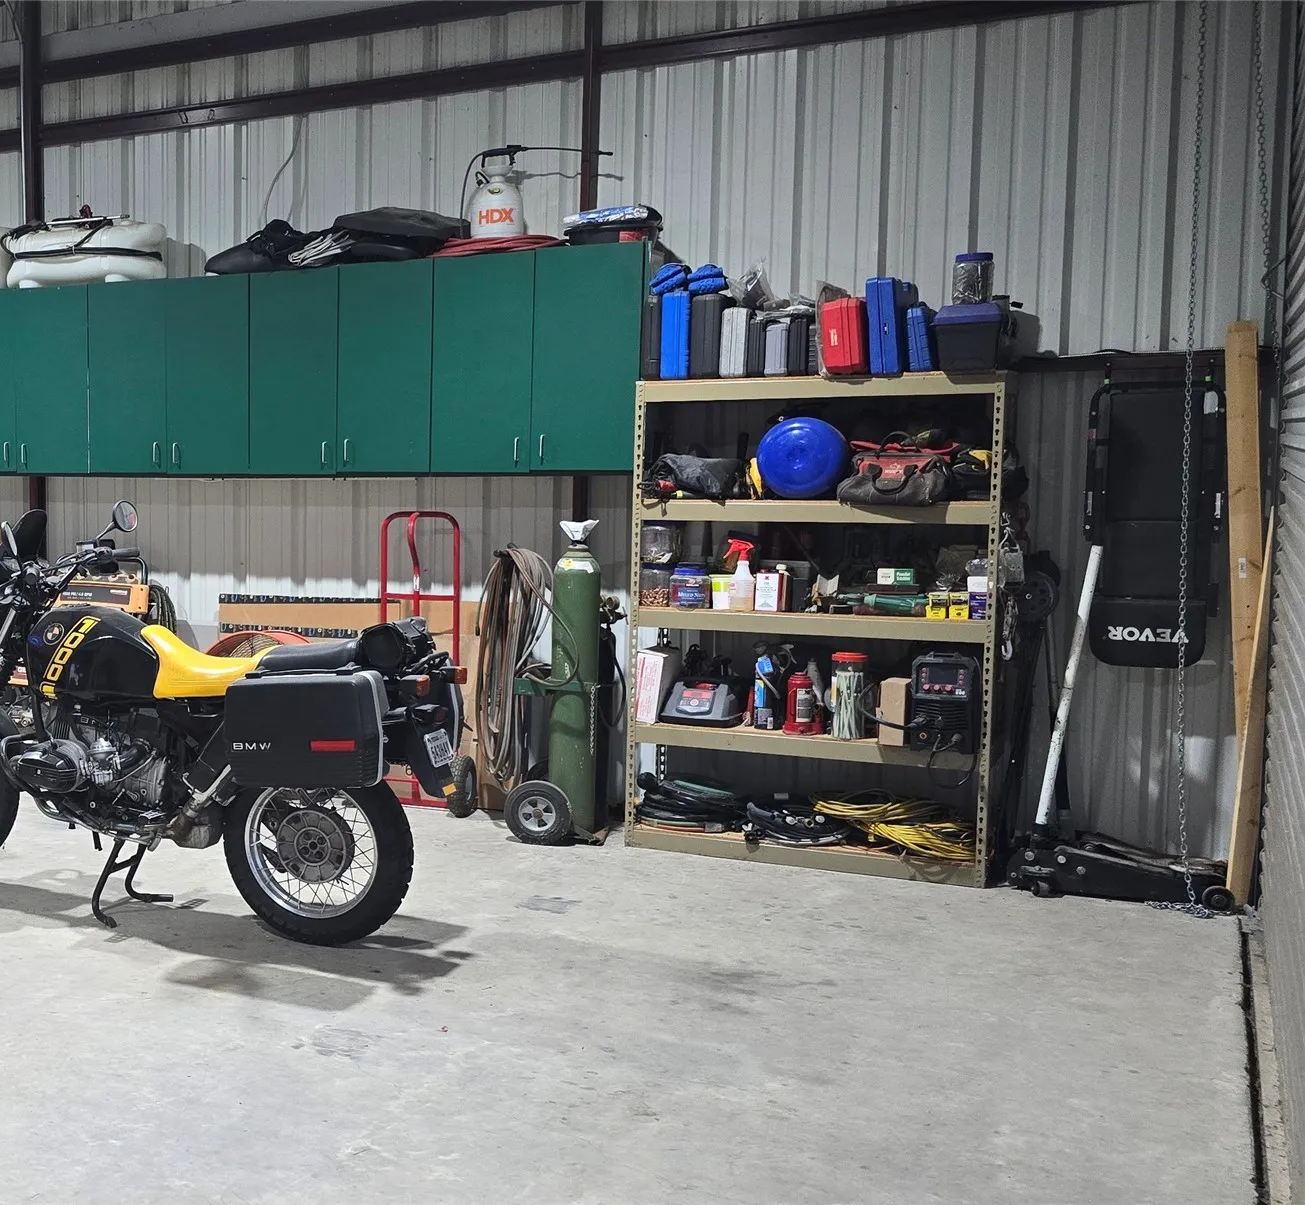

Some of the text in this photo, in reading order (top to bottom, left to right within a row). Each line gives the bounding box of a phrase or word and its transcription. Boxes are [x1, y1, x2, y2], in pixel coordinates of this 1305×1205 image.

[479, 208, 514, 225] HDX
[1107, 626, 1189, 643] VEVOR
[47, 618, 95, 681] 1000
[233, 742, 271, 750] BMW
